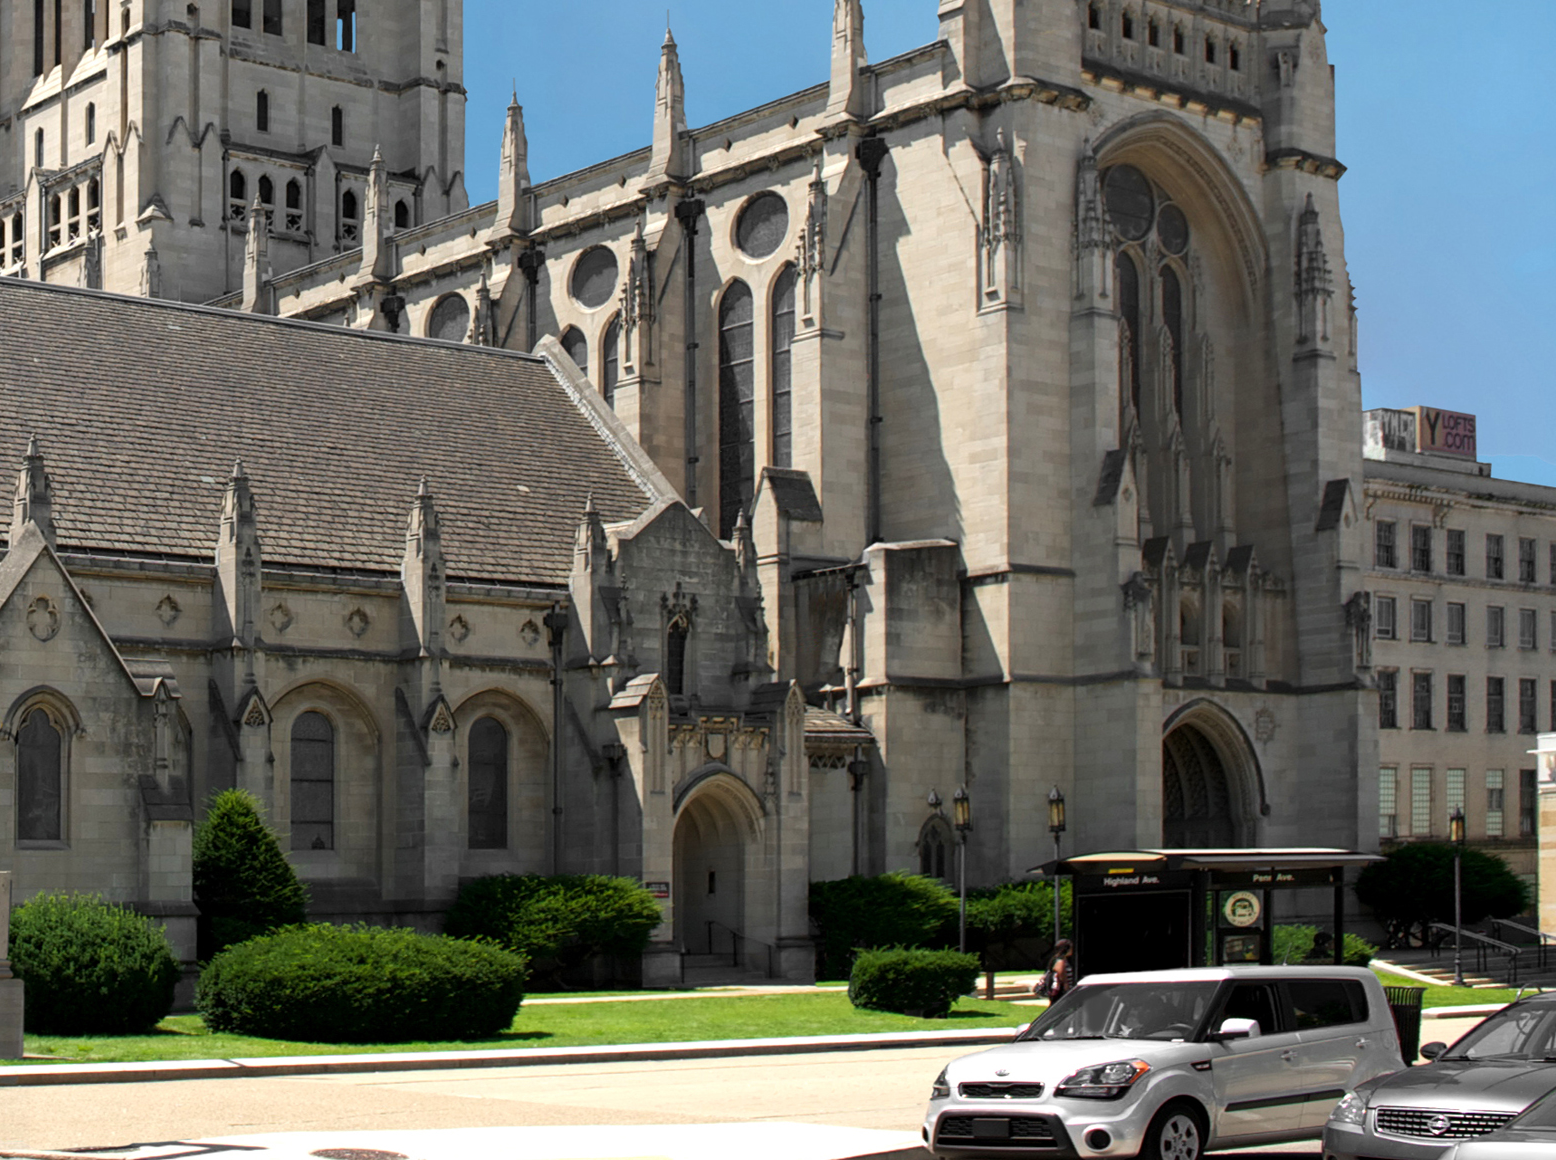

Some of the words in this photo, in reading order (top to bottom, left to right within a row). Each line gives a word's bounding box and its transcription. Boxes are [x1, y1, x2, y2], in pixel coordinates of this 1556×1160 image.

[1426, 411, 1441, 446] Y
[1443, 415, 1475, 433] LOFTS
[1104, 876, 1139, 887] Highland
[1142, 875, 1160, 884] Ave.
[1276, 873, 1295, 882] Ave.
